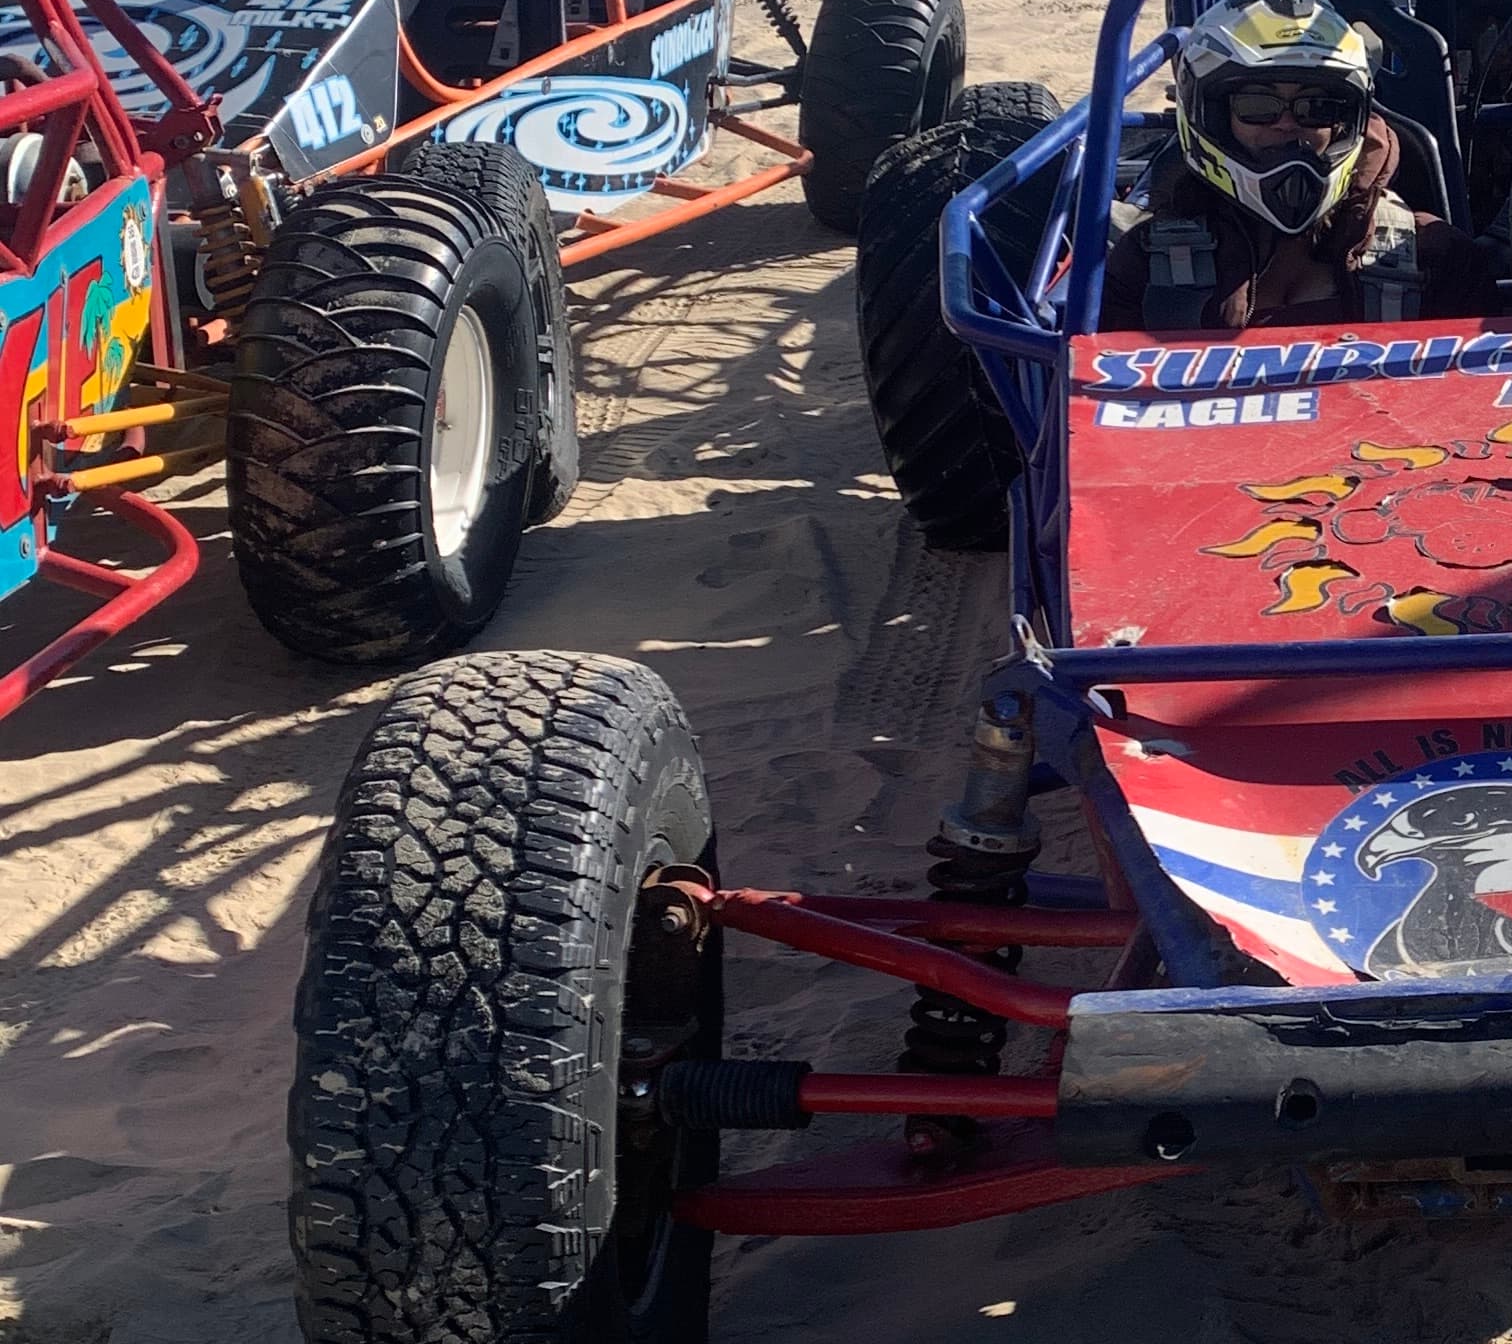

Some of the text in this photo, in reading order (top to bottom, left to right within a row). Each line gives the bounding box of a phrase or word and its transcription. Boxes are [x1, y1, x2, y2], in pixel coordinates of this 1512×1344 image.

[283, 74, 363, 151] 412
[1096, 390, 1319, 429] EAGLE
[1334, 749, 1404, 794] ALL
[1415, 728, 1459, 761] IS
